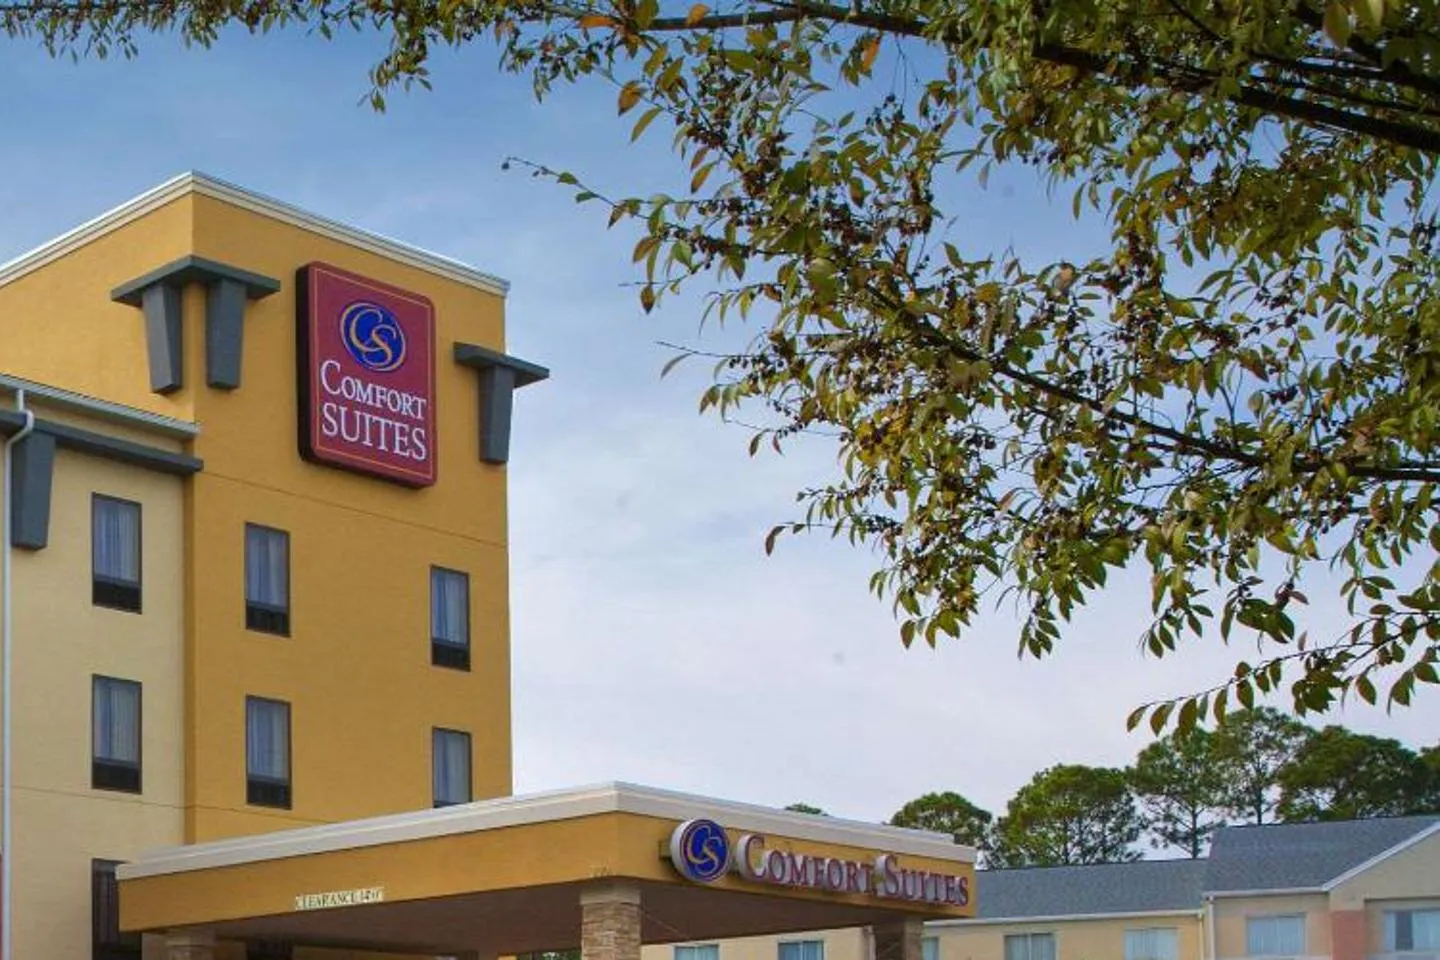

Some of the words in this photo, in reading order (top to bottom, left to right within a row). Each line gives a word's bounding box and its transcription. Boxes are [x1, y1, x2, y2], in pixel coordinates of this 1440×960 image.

[320, 359, 427, 420] COMFORT
[321, 402, 427, 461] SUITES
[740, 833, 877, 896] COMFORT
[879, 853, 969, 907] SUITES
